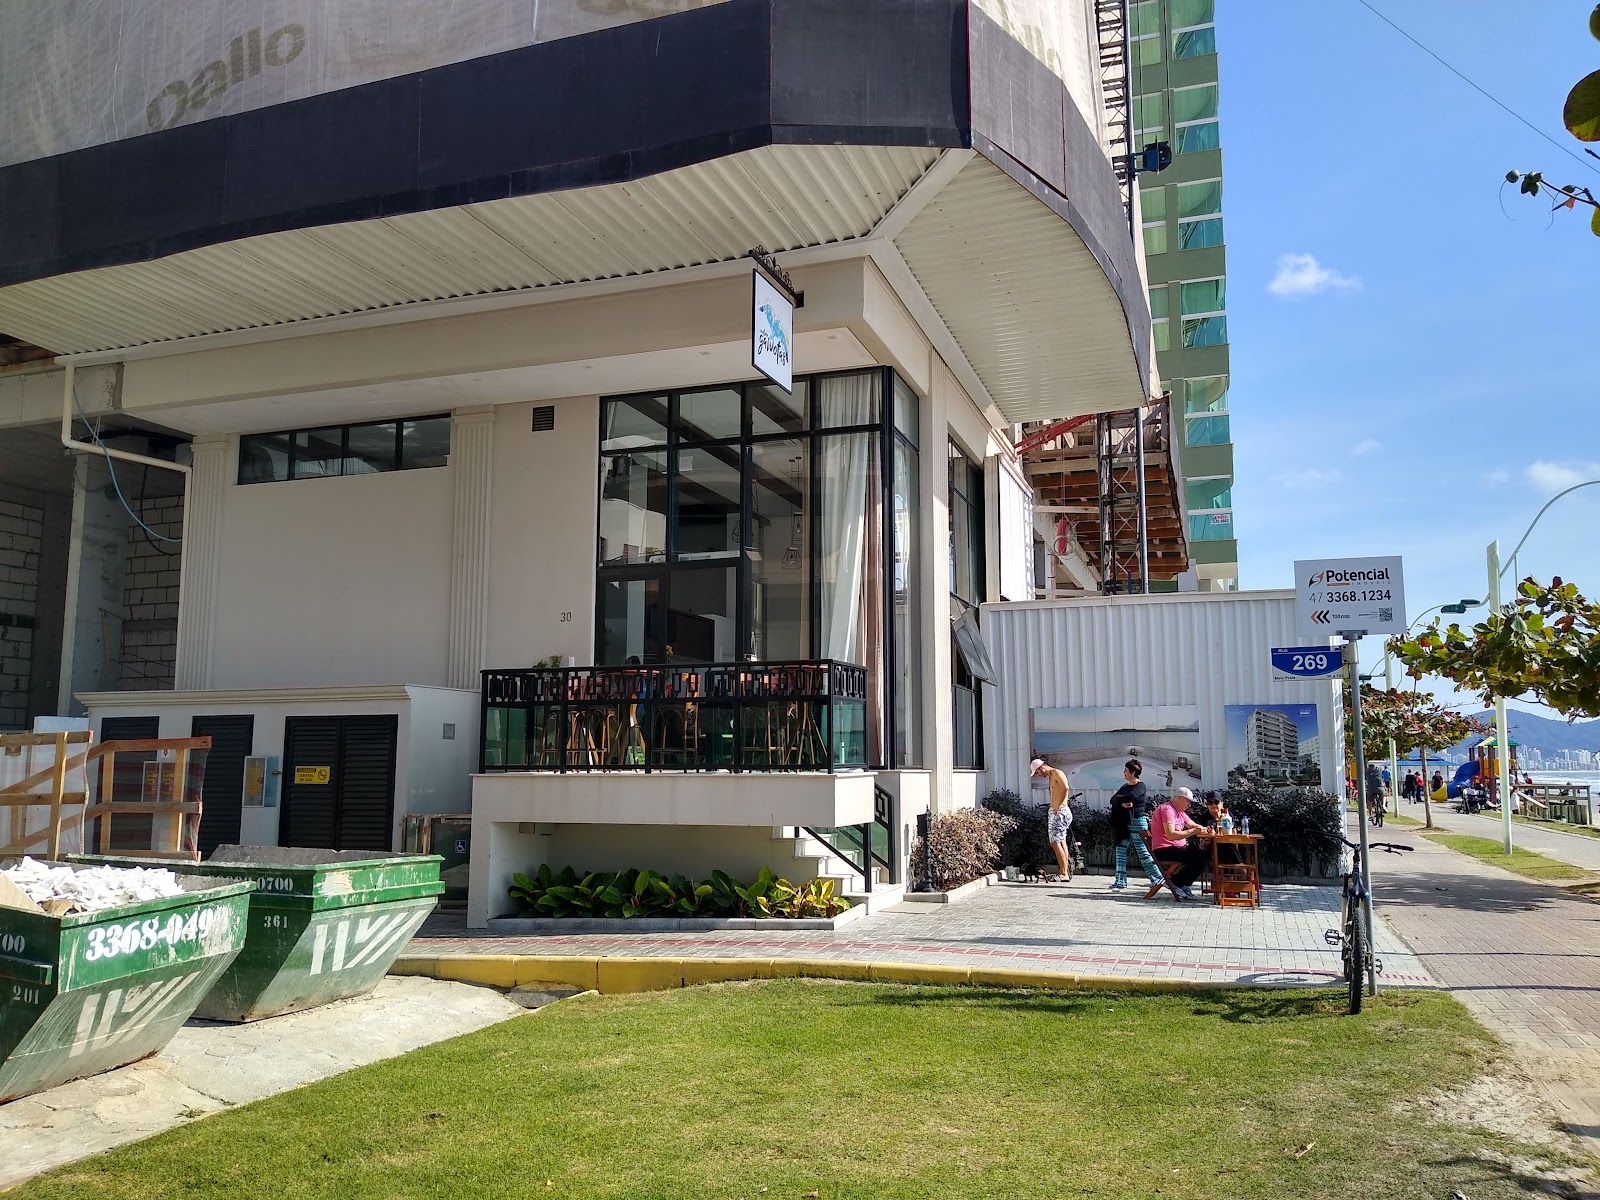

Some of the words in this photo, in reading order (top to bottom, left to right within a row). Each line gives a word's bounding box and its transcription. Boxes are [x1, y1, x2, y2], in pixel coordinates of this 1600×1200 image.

[1326, 567, 1390, 582] Potencial
[1309, 592, 1323, 604] 47
[1326, 589, 1392, 603] 3368.1234
[560, 611, 572, 623] 30
[1292, 654, 1328, 671] 269
[256, 877, 293, 891] 0700
[264, 914, 288, 928] 361
[0, 931, 25, 954] 00
[13, 985, 39, 1005] 201
